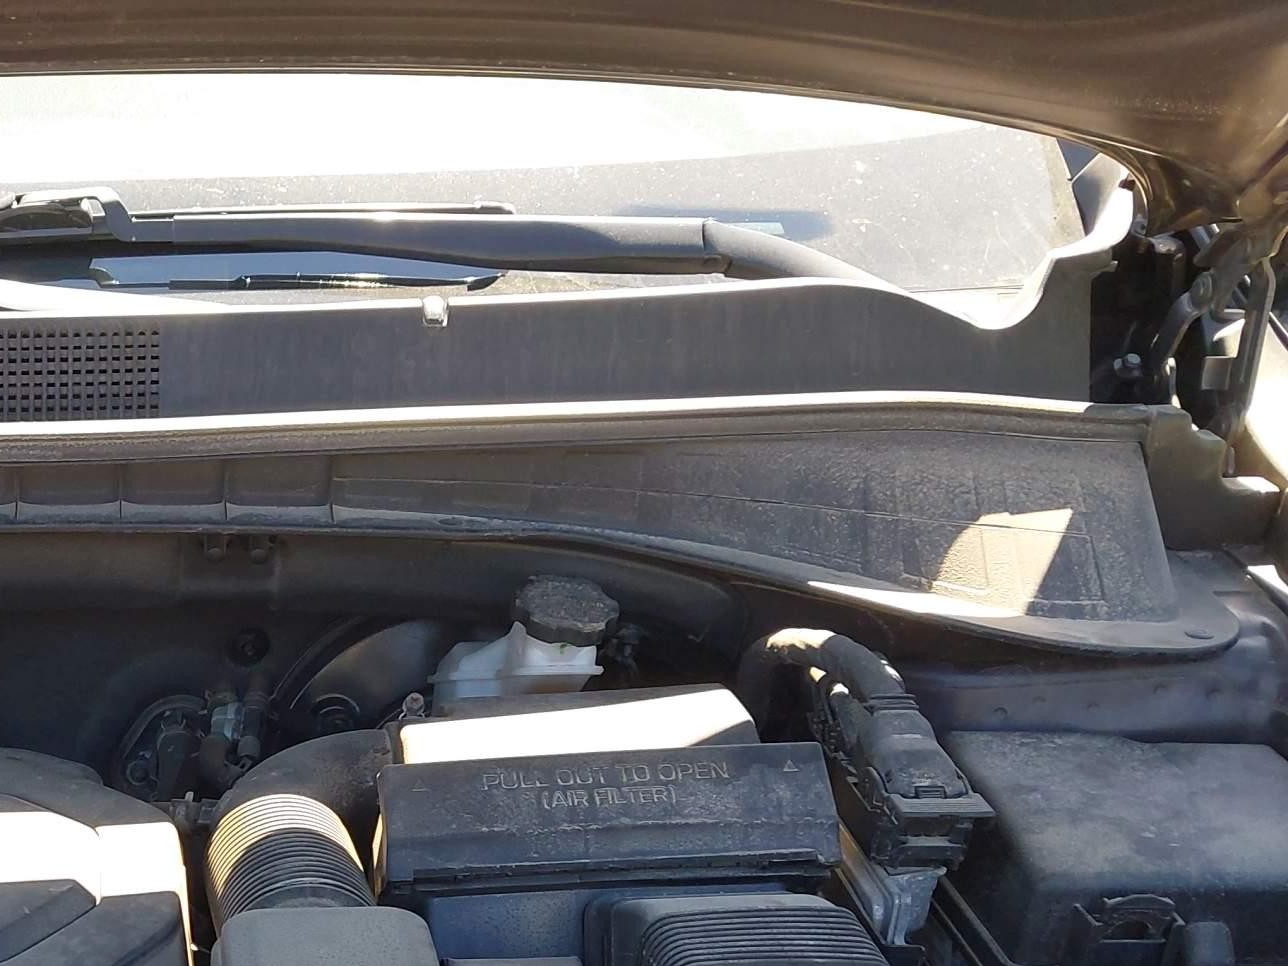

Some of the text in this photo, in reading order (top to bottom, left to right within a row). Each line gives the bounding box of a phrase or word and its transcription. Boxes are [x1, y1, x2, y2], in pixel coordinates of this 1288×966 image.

[481, 761, 731, 791] PULL OUT TO OPEN
[542, 784, 678, 809] (AIR FILTER)
